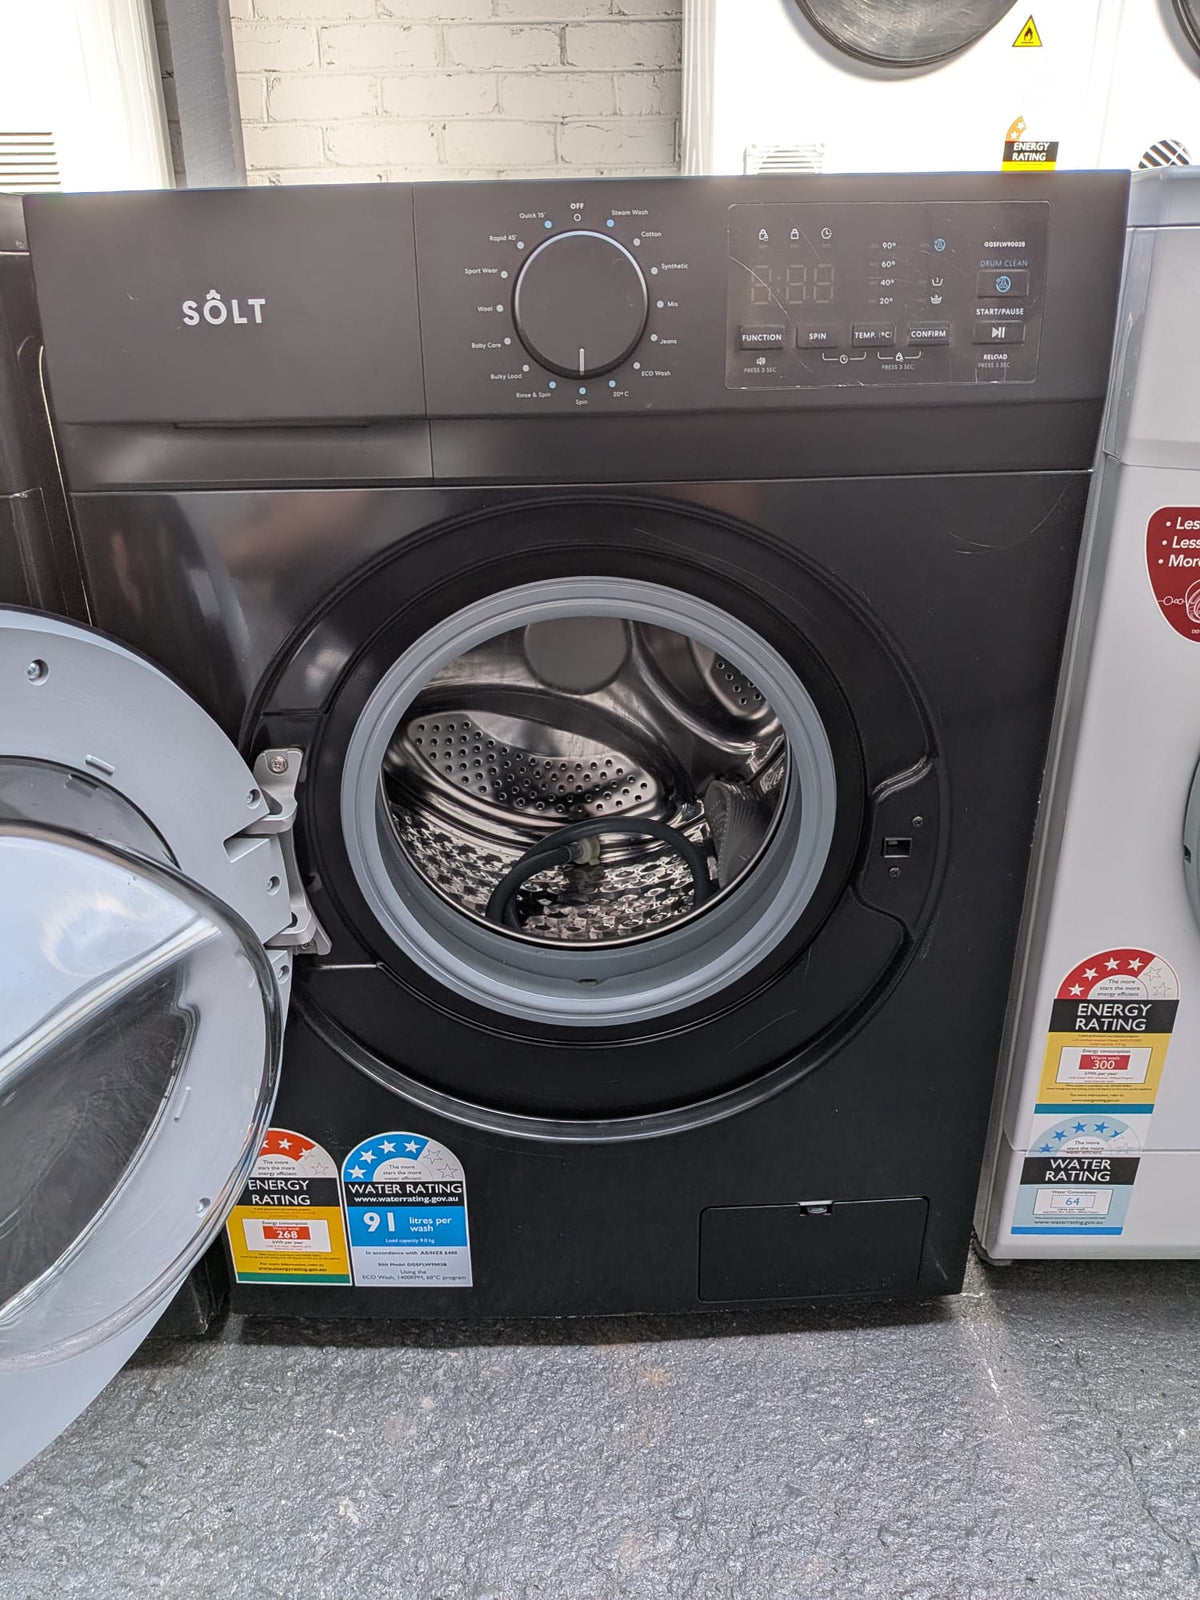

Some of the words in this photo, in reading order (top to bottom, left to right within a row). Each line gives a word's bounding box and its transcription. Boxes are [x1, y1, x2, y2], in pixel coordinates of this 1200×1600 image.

[1013, 142, 1050, 151] ENERGY
[1012, 152, 1047, 161] RATING
[570, 202, 585, 210] OFF
[641, 230, 662, 238] Cotton
[661, 262, 689, 271] Synthetic
[1004, 259, 1029, 267] CLEAN
[182, 289, 266, 326] SÔLT
[976, 307, 1025, 316] START/PAUSE
[742, 333, 783, 342] FUNCTION
[808, 332, 827, 340] SPIN
[855, 331, 877, 339] TEMP.
[911, 329, 947, 338] CONFIRM
[471, 342, 486, 350] Baby
[538, 391, 552, 399] Spin
[1077, 1003, 1153, 1017] ENERGY
[1075, 1018, 1147, 1031] RATING
[1092, 1060, 1115, 1070] 300
[1050, 1159, 1111, 1170] WATER
[1045, 1170, 1111, 1182] RATING
[248, 1179, 309, 1191] ENERGY
[348, 1184, 402, 1194] WATER
[406, 1183, 462, 1194] RATING
[252, 1194, 311, 1205] RATING
[354, 1195, 459, 1204] www.waterrating.gov.au
[1065, 1197, 1080, 1206] 64
[363, 1212, 395, 1232] 91
[409, 1216, 433, 1225] litres
[436, 1217, 452, 1226] per
[410, 1224, 434, 1232] wash
[276, 1230, 298, 1239] 268
